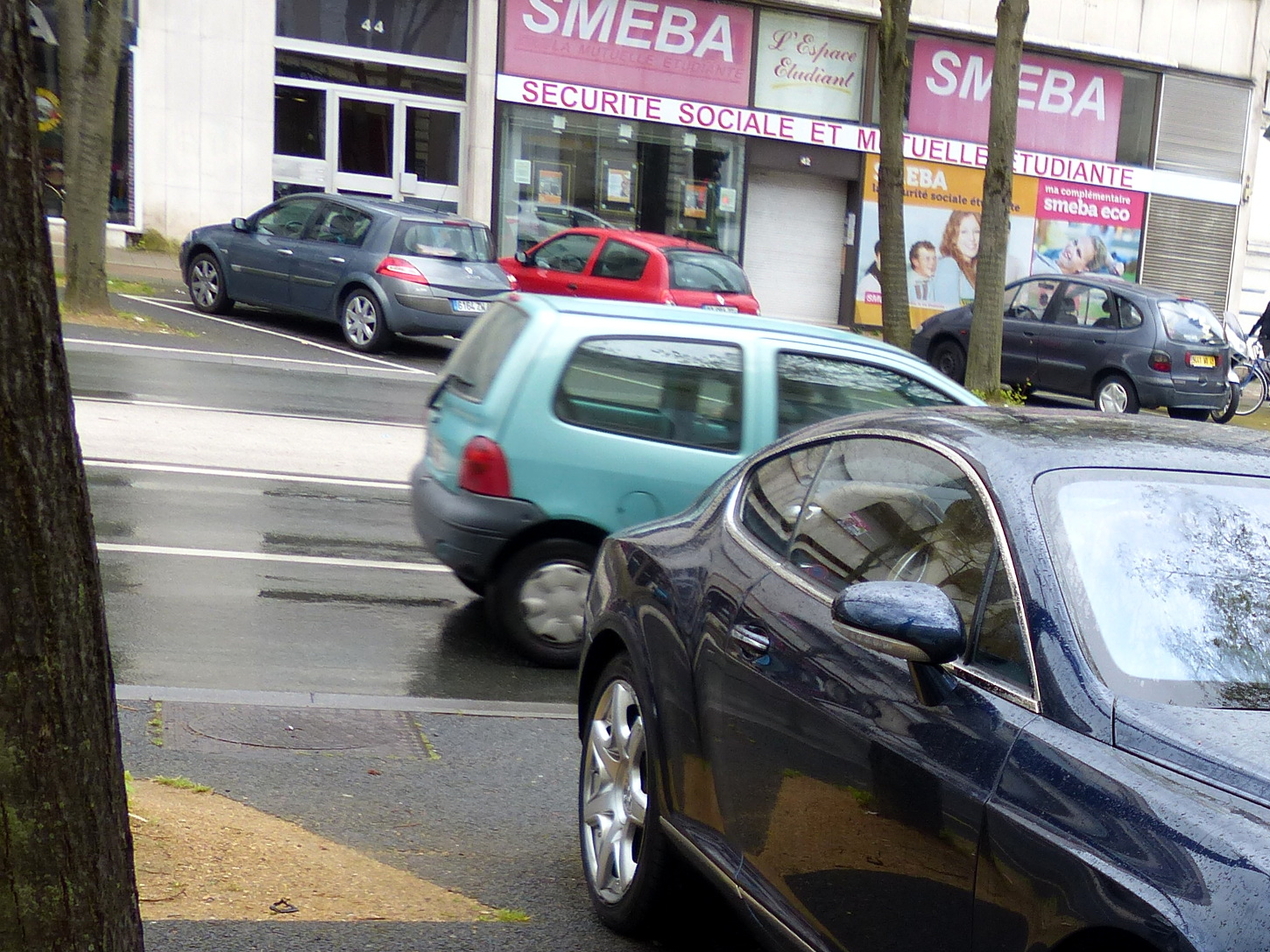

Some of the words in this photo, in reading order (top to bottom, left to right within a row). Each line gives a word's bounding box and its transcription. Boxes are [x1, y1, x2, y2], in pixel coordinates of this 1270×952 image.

[361, 18, 385, 33] 44
[522, 0, 734, 63] SMEBA
[768, 29, 857, 63] L'Espace
[774, 57, 855, 88] Etudiant
[925, 50, 1106, 121] SMEBA
[522, 80, 661, 120] SECURITE
[678, 103, 794, 139] SOCIALE
[811, 121, 842, 145] ET
[857, 129, 988, 167] MUELLE
[873, 161, 948, 191] SEBA
[930, 193, 967, 206] sociale
[1044, 197, 1098, 218] smeba
[1101, 205, 1130, 222] eco
[1045, 185, 1059, 195] ma
[1061, 188, 1131, 205] complémentaire
